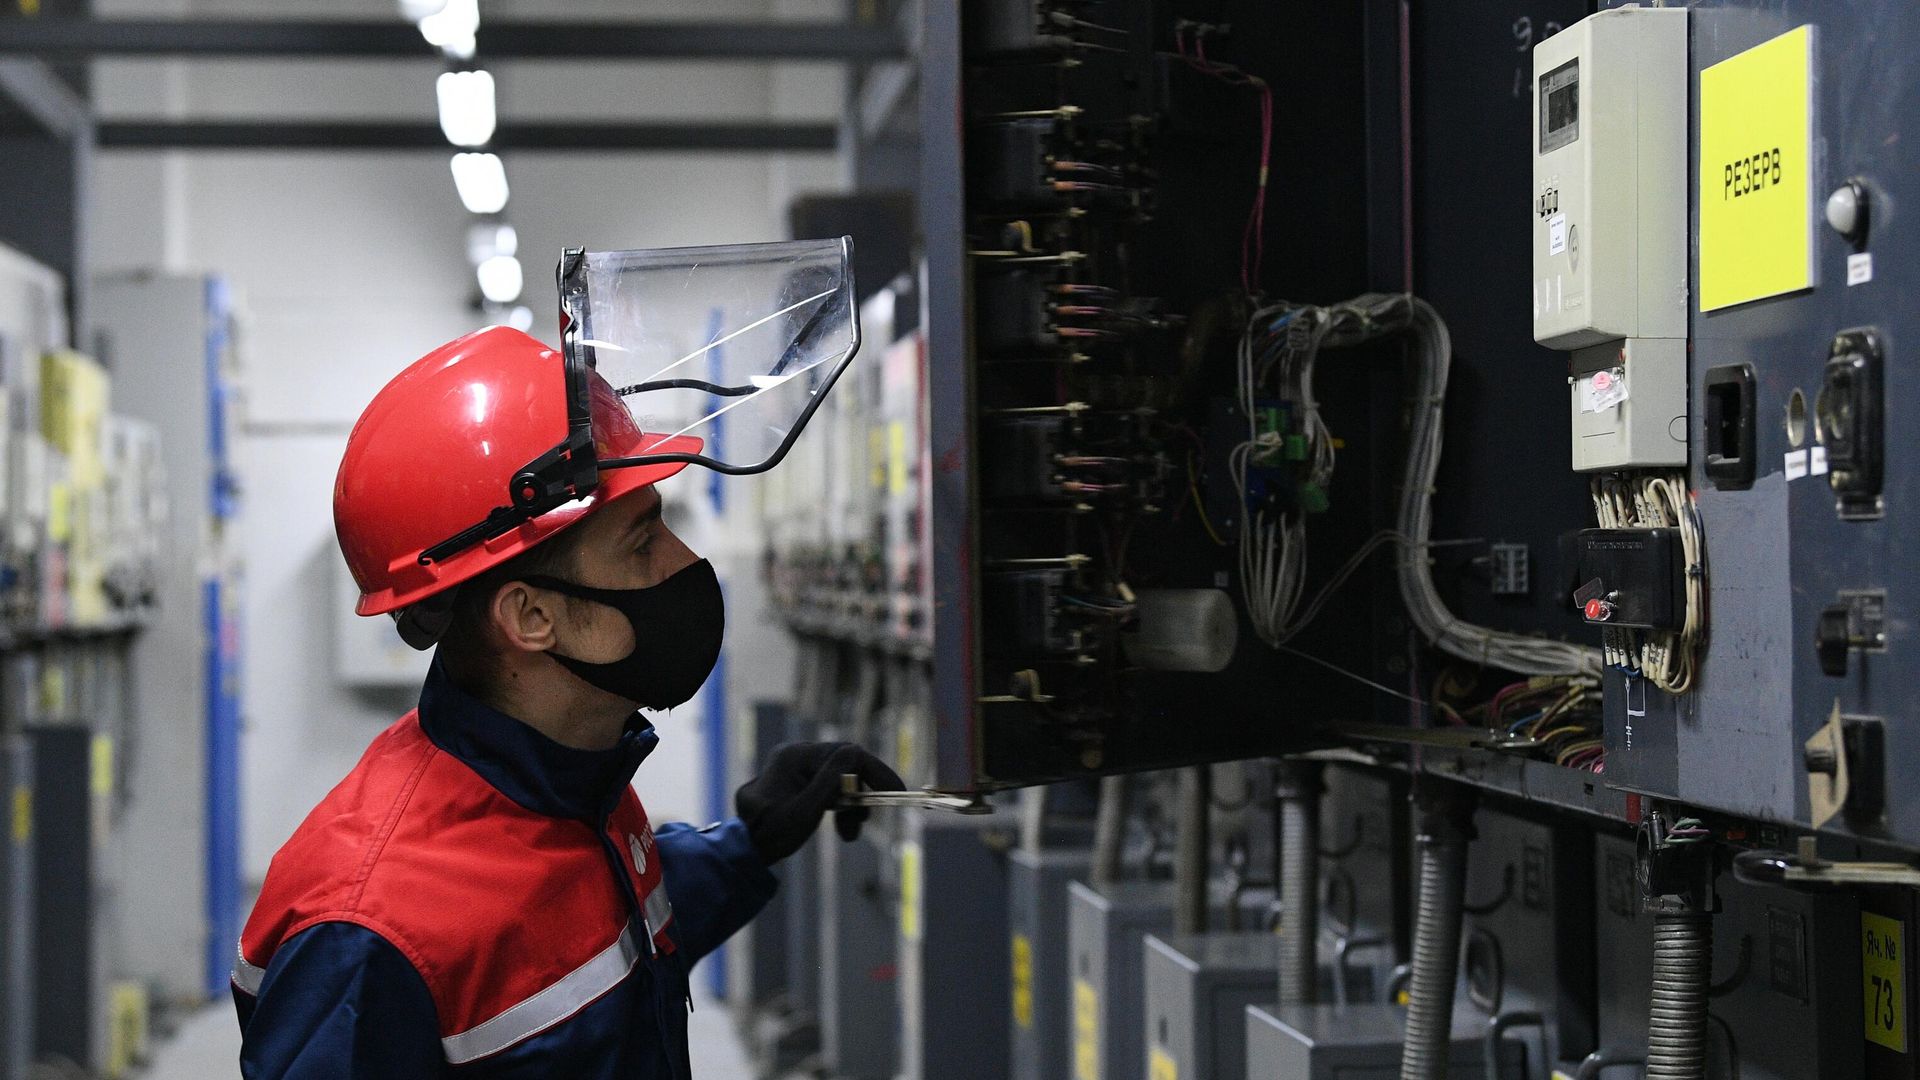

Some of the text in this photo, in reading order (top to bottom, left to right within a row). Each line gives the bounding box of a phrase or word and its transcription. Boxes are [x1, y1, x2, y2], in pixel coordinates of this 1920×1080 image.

[1724, 147, 1781, 201] РЕЗЕРВ
[1866, 929, 1896, 961] Яч. №
[1871, 975, 1894, 1031] 73
